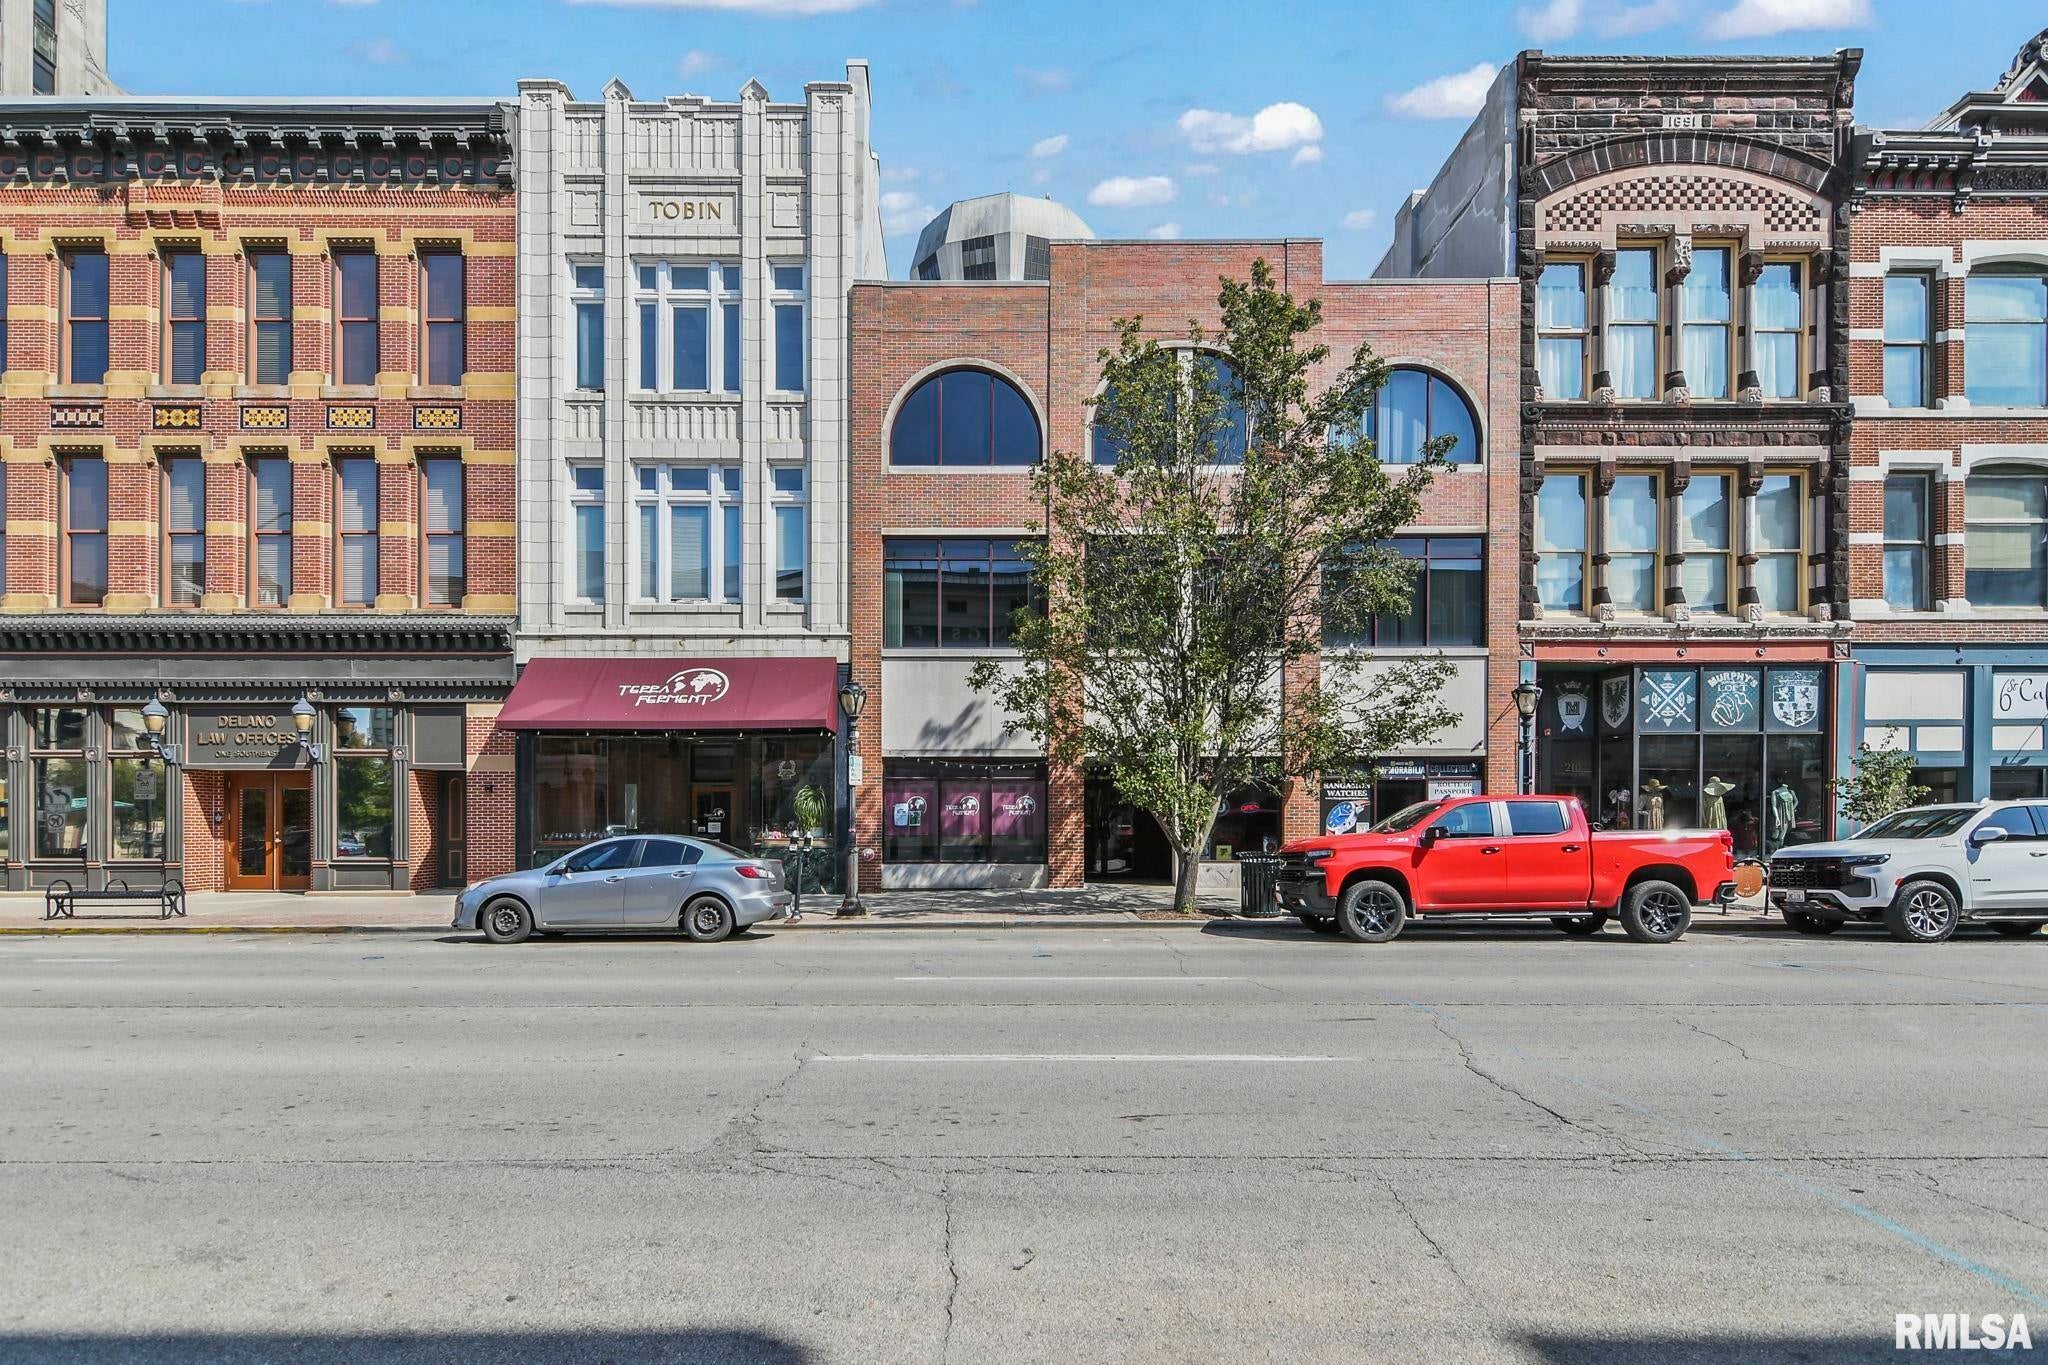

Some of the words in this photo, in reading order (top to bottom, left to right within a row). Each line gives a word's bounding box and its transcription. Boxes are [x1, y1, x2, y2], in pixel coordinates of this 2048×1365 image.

[648, 201, 722, 220] TOBIN
[1717, 684, 1747, 692] LOFT
[217, 715, 277, 728] DELANO
[197, 731, 228, 746] LAW
[234, 731, 297, 746] OFFICES
[215, 750, 231, 758] ONE
